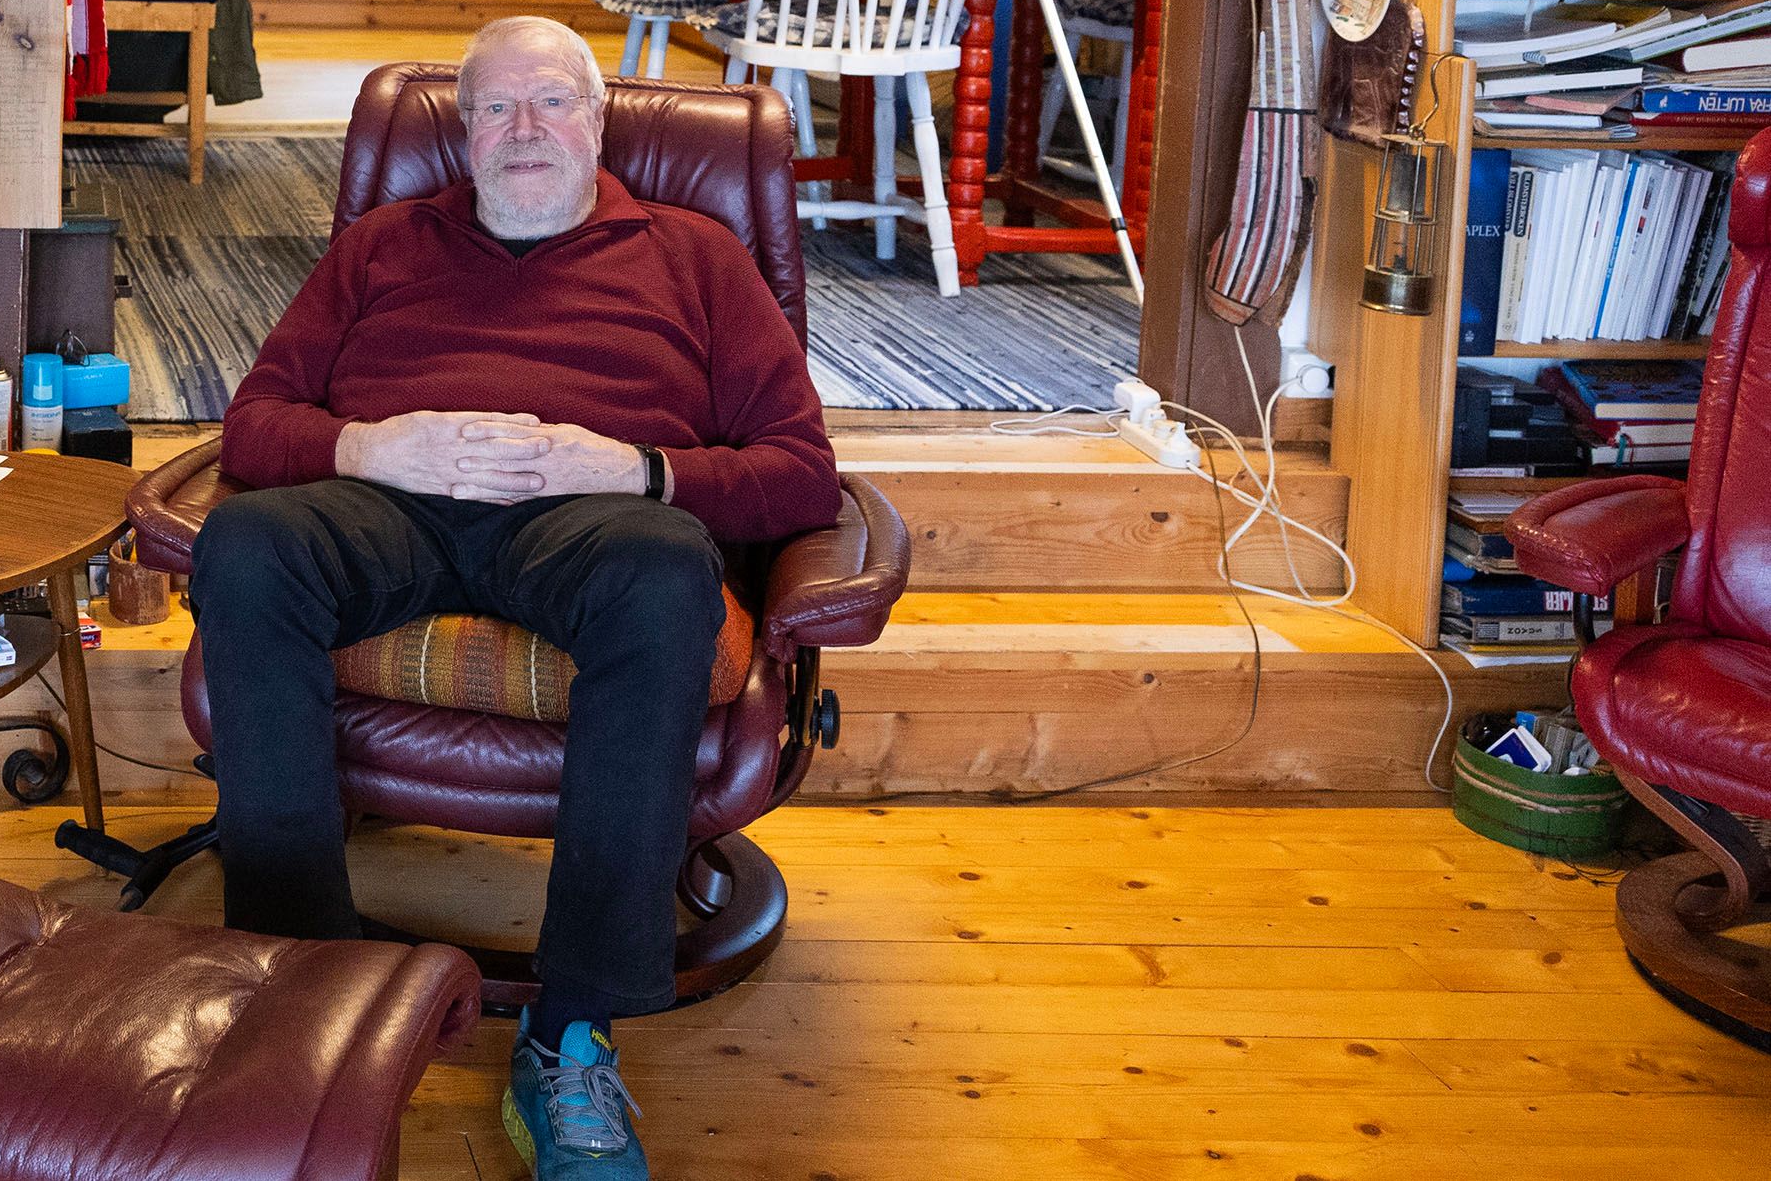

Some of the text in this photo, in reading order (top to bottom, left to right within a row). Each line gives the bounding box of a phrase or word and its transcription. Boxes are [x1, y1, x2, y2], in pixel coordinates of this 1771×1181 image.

[1698, 97, 1771, 112] FRA LUFTEN
[1466, 225, 1500, 237] APLEX
[1545, 591, 1608, 612] STKJER
